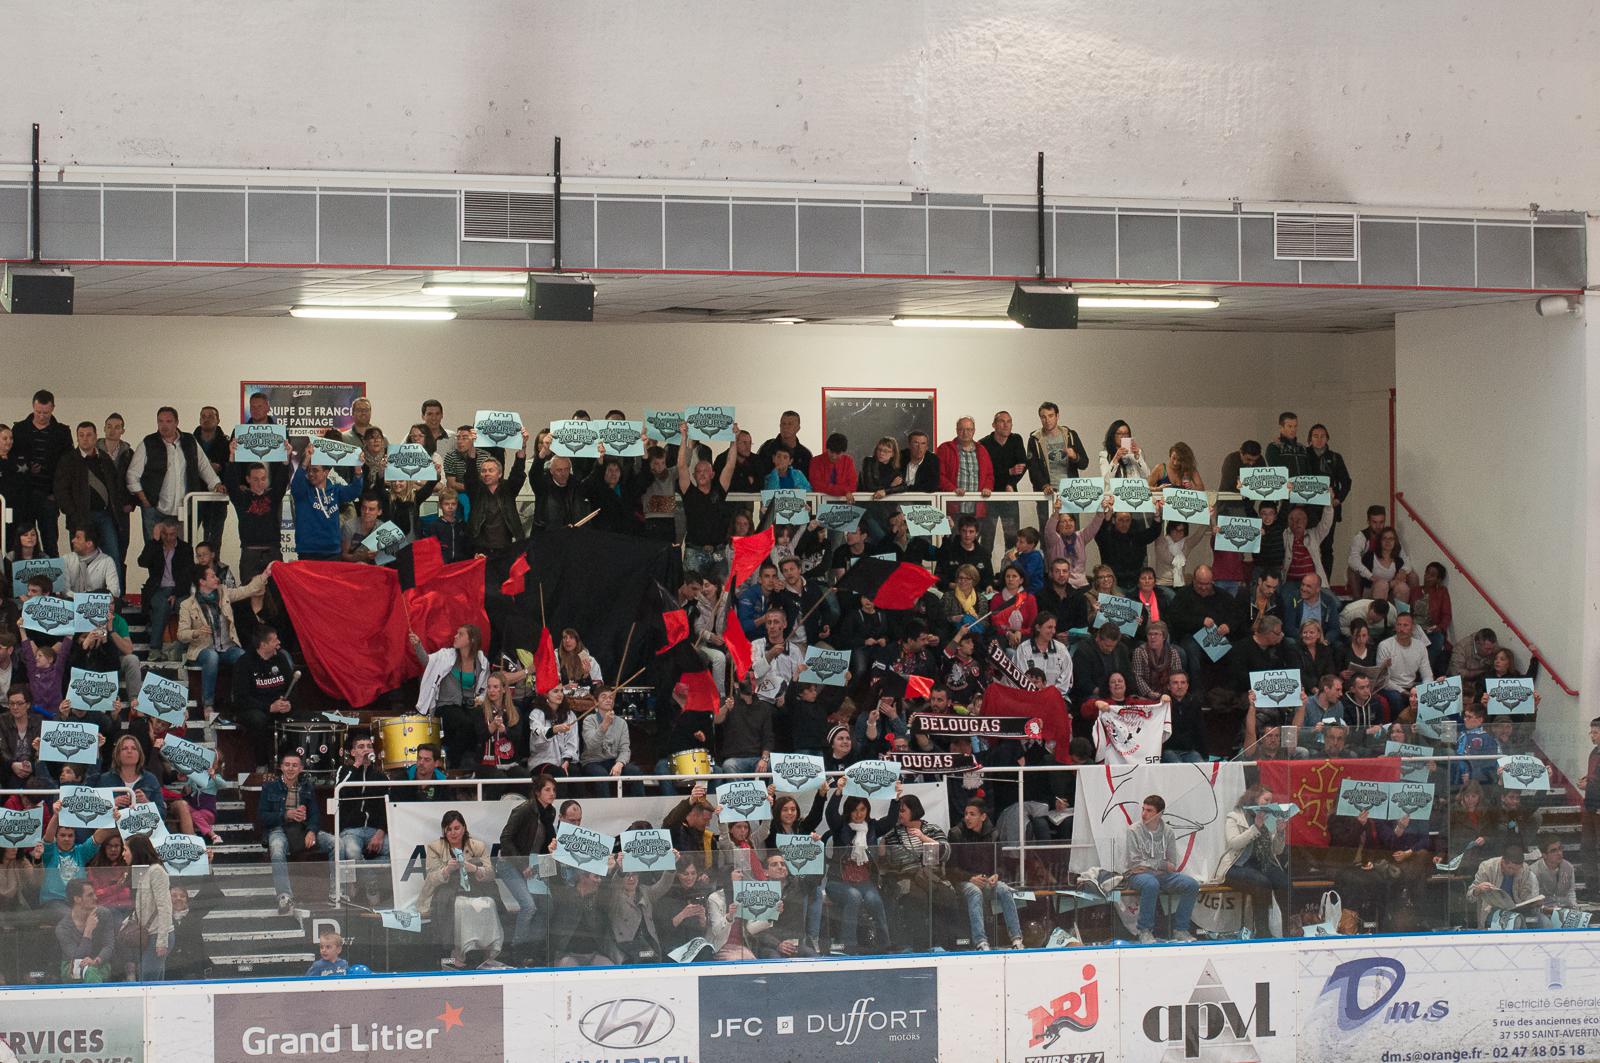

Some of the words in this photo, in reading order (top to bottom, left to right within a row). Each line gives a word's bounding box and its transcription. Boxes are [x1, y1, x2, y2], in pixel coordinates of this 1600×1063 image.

[267, 406, 296, 416] QUIPE
[298, 406, 311, 416] DE
[276, 417, 288, 426] DE
[290, 418, 334, 426] PATINAGE
[83, 608, 110, 619] TOUR
[992, 648, 1040, 692] BELOUG
[919, 717, 1001, 732] BELOUGAS
[50, 736, 89, 748] TOURS
[727, 796, 761, 806] TOURS
[69, 801, 107, 814] TOURS
[565, 841, 605, 860] TOURS
[631, 845, 665, 856] TOURS
[1492, 1019, 1498, 1027] 5
[1517, 1018, 1533, 1026] des
[1535, 1016, 1581, 1026] anciennes
[1583, 1015, 1600, 1025] éco
[711, 1017, 763, 1038] JFC
[242, 1024, 341, 1056] Grand
[351, 1023, 440, 1052] Litier
[1500, 1031, 1510, 1040] 37
[1513, 1030, 1530, 1039] 550
[1381, 1047, 1482, 1063] dm.s@orange.fr
[1492, 1047, 1508, 1058] 02
[1511, 1047, 1527, 1057] 47
[1550, 1045, 1566, 1056] 05
[1570, 1044, 1585, 1056] 18
